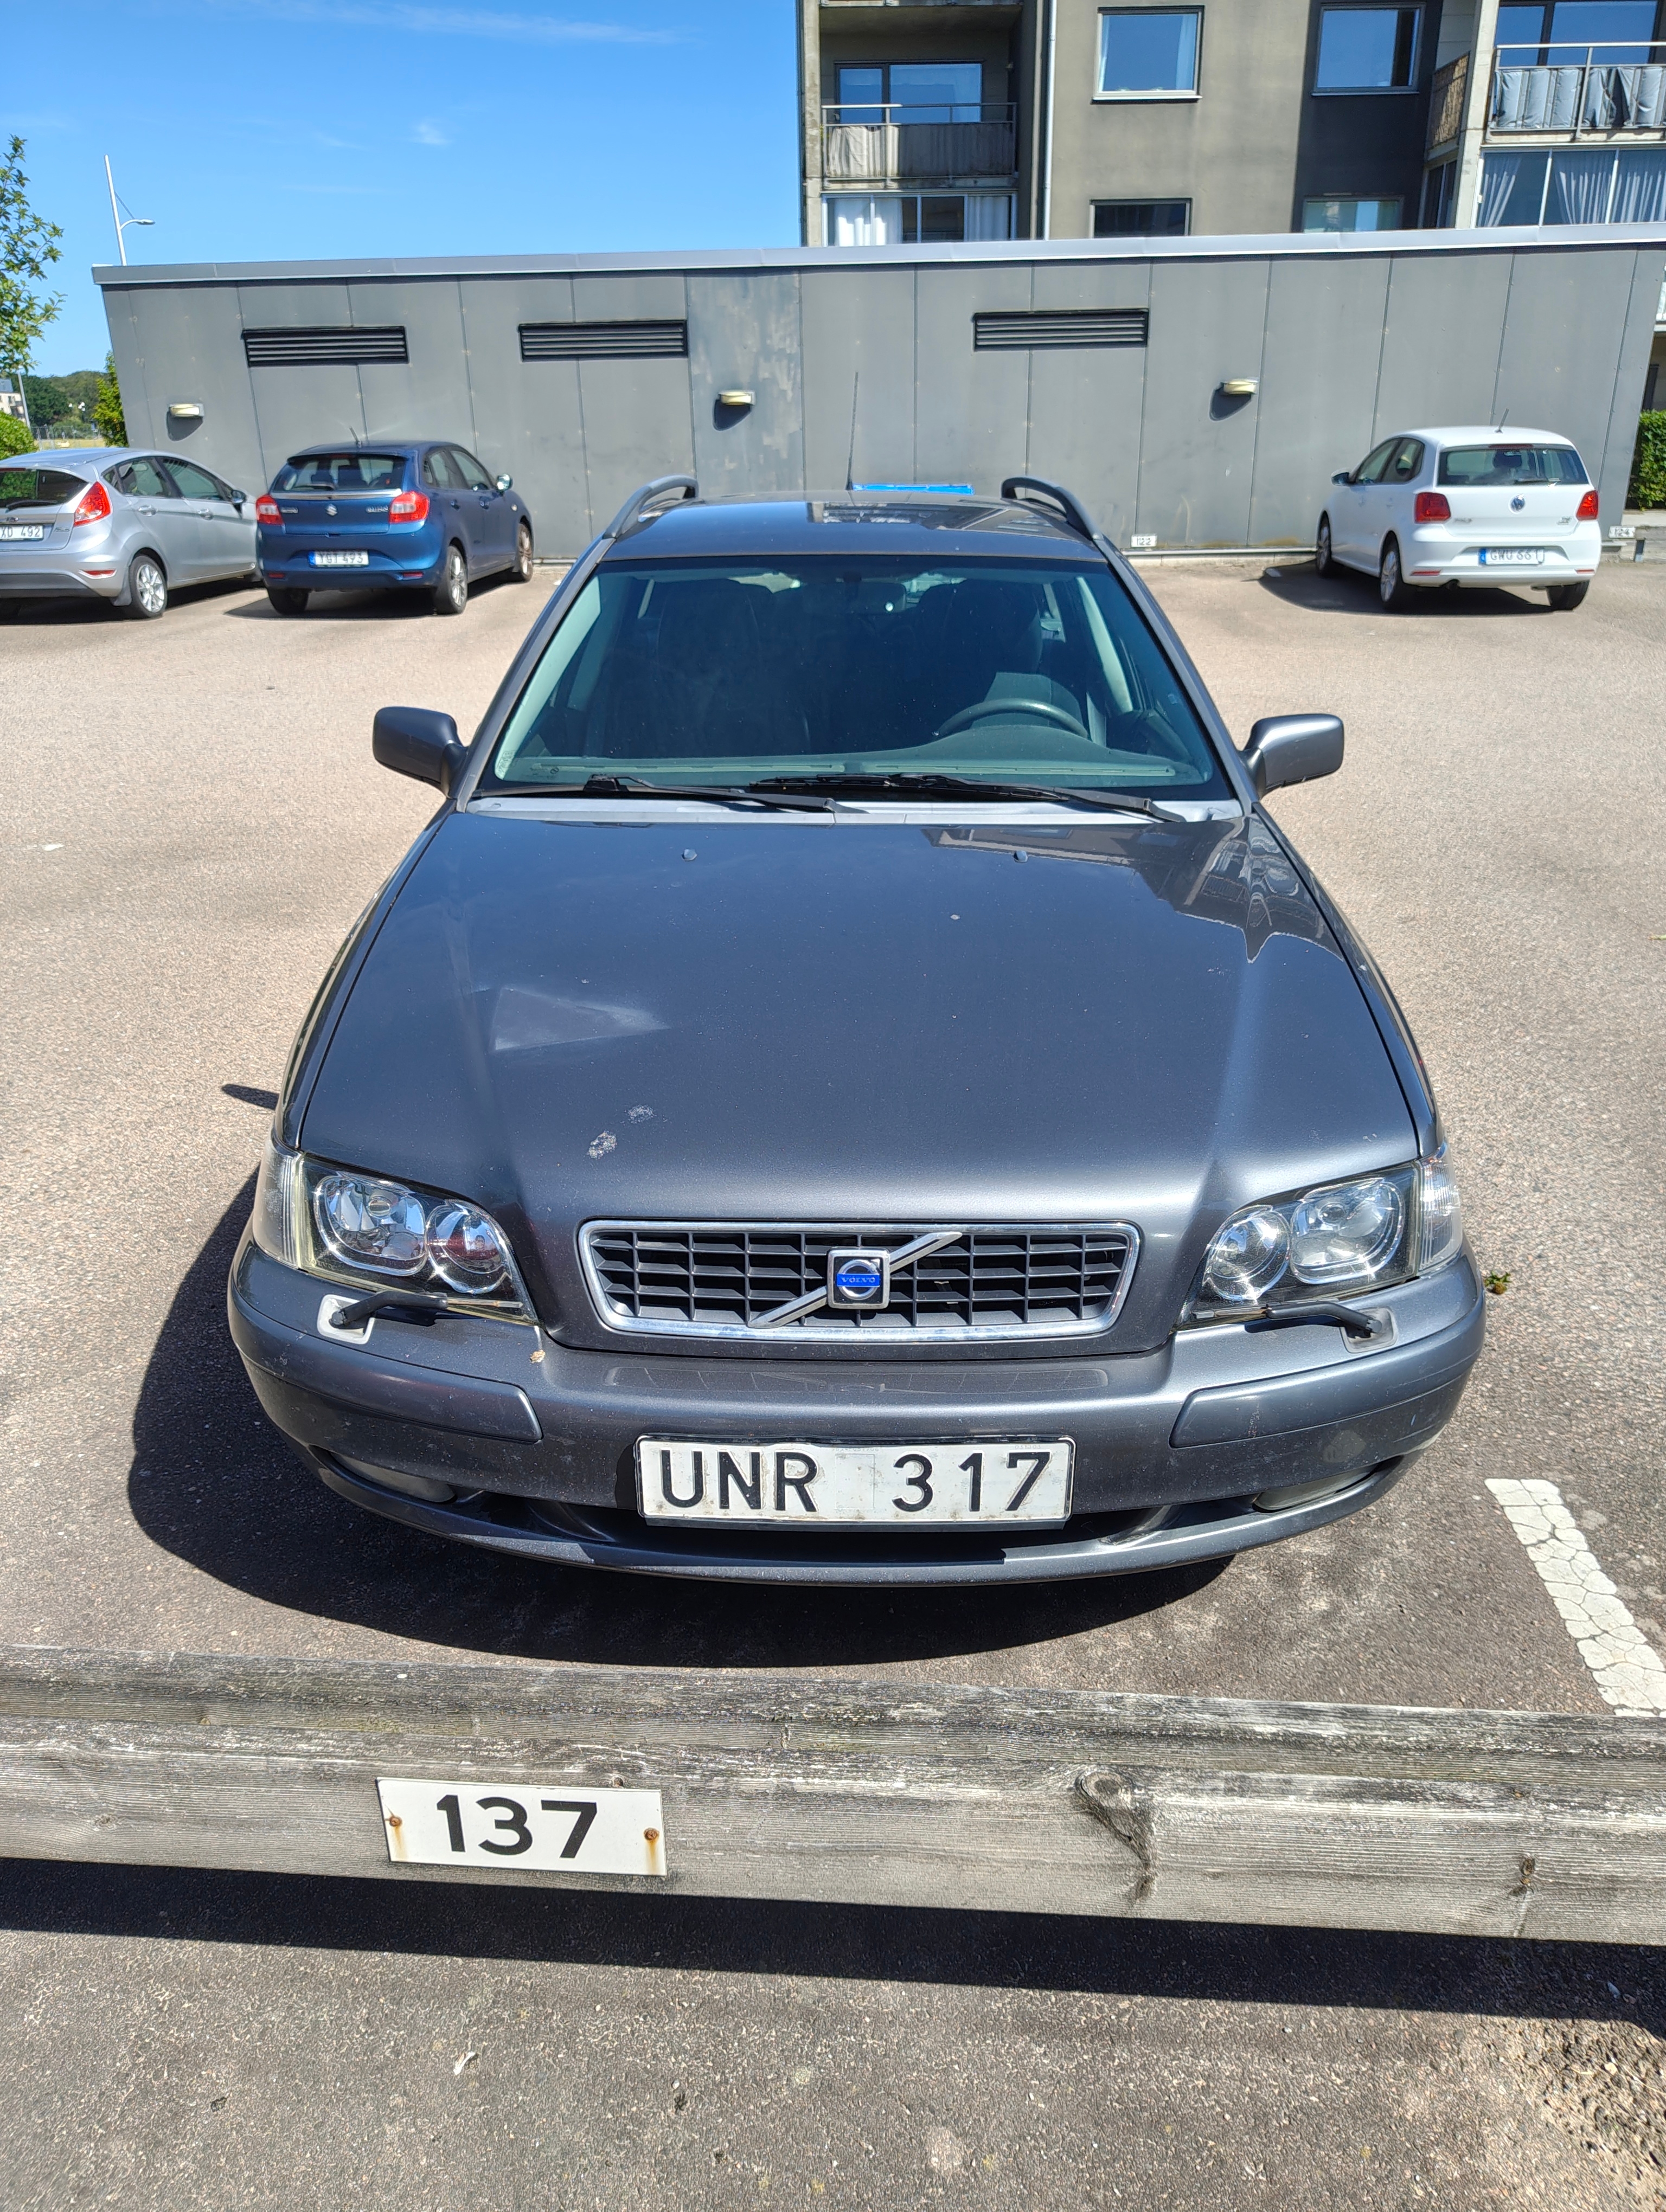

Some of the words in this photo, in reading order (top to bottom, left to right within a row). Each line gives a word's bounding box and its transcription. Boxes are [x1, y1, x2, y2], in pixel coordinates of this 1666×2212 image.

[21, 525, 41, 537] 492
[661, 1449, 819, 1513] UNR
[891, 1451, 1052, 1513] 317
[436, 1794, 598, 1859] 137
